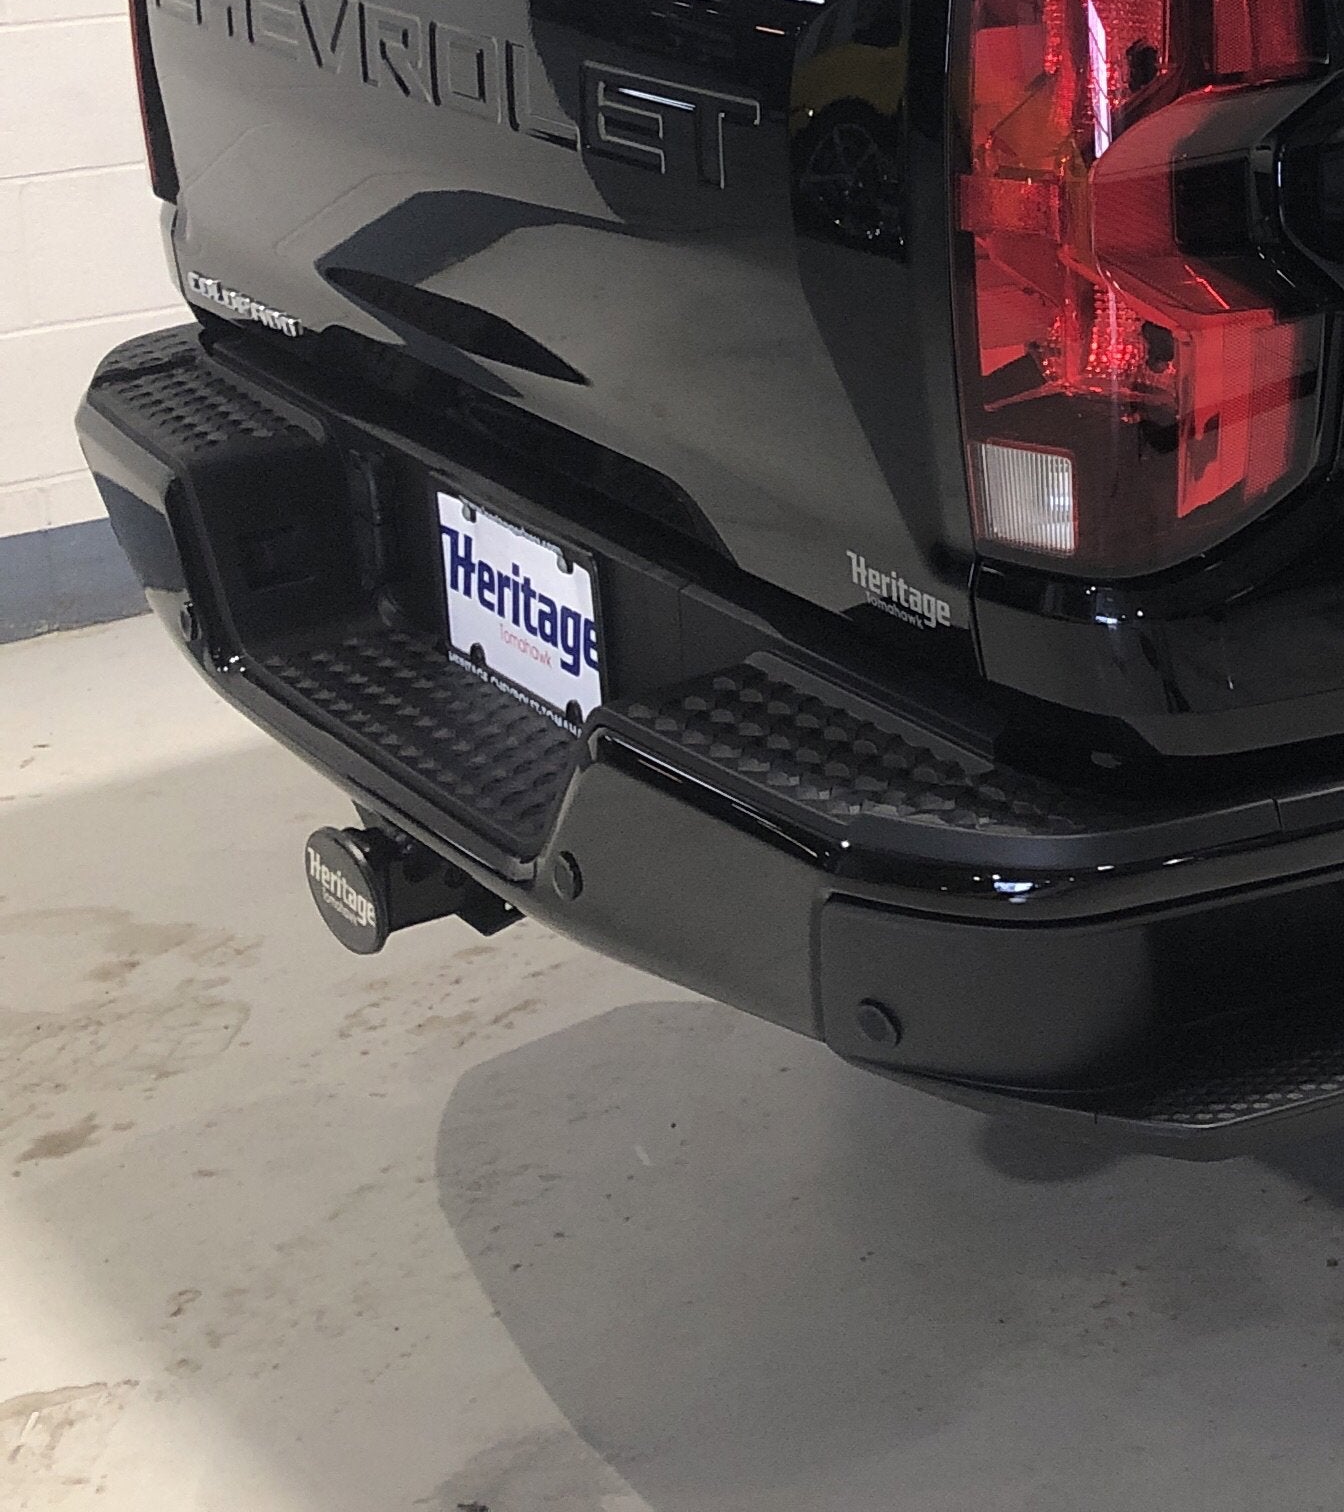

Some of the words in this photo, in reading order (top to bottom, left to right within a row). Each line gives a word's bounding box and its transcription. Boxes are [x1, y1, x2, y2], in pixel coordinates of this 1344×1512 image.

[440, 524, 600, 677] Heritage
[846, 549, 951, 628] Heritage
[865, 590, 924, 629] Tomahawk
[500, 622, 552, 670] Tomahawk
[307, 846, 377, 928] Heritage
